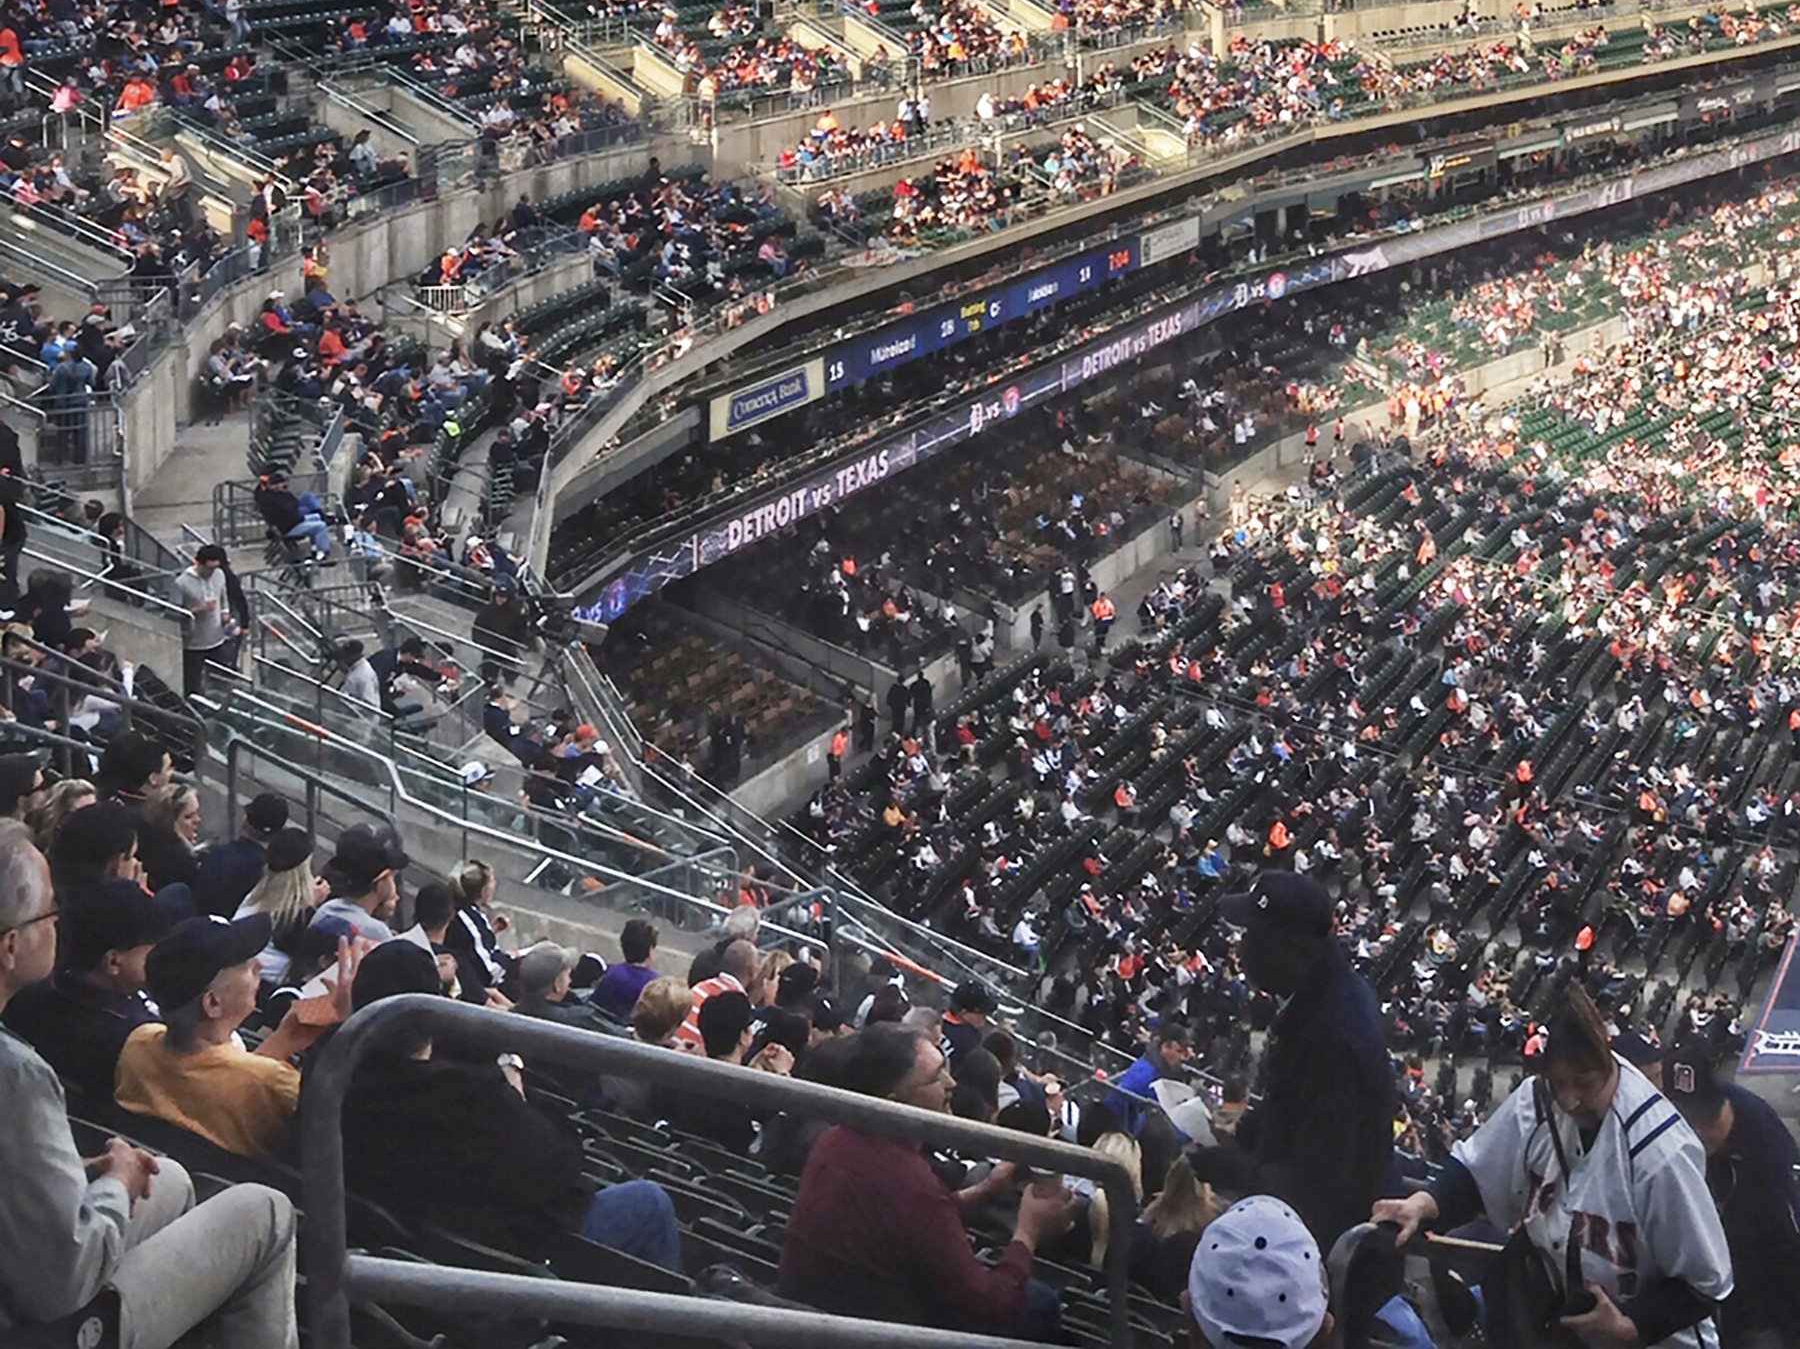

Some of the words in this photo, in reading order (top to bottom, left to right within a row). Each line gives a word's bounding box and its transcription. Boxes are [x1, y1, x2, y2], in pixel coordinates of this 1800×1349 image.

[1081, 339, 1131, 379] DETROIT
[1147, 312, 1182, 346] TEXAS
[779, 378, 803, 400] Bank
[727, 488, 808, 550] DETROIT
[836, 450, 889, 498] TEXAS
